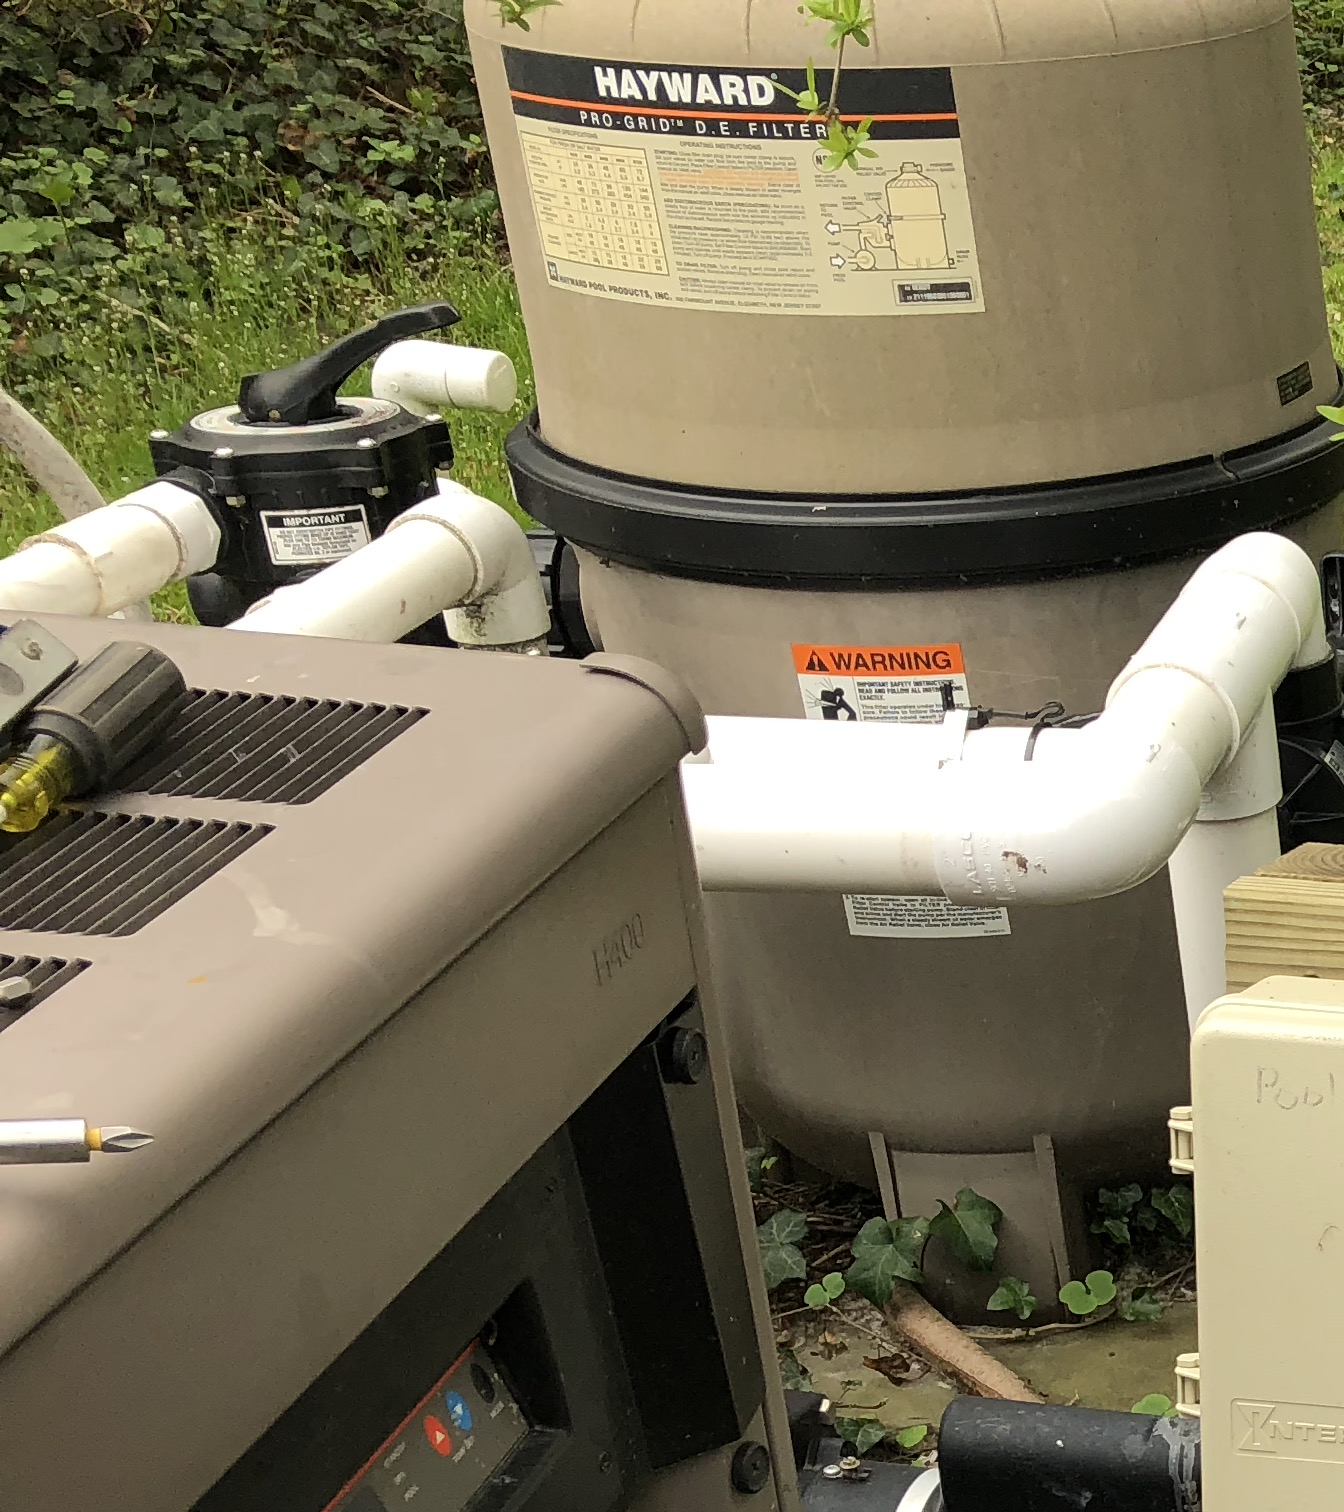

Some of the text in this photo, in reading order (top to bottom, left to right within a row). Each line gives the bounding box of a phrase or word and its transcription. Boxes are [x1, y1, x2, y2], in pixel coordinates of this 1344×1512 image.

[594, 66, 775, 106] HAYWARD
[695, 120, 740, 136] D.E.
[748, 122, 827, 138] FILTER
[588, 281, 607, 292] POOL
[282, 513, 346, 527] IMPORTANT
[829, 650, 952, 671] WARNING
[856, 680, 889, 688] IMPORTANT
